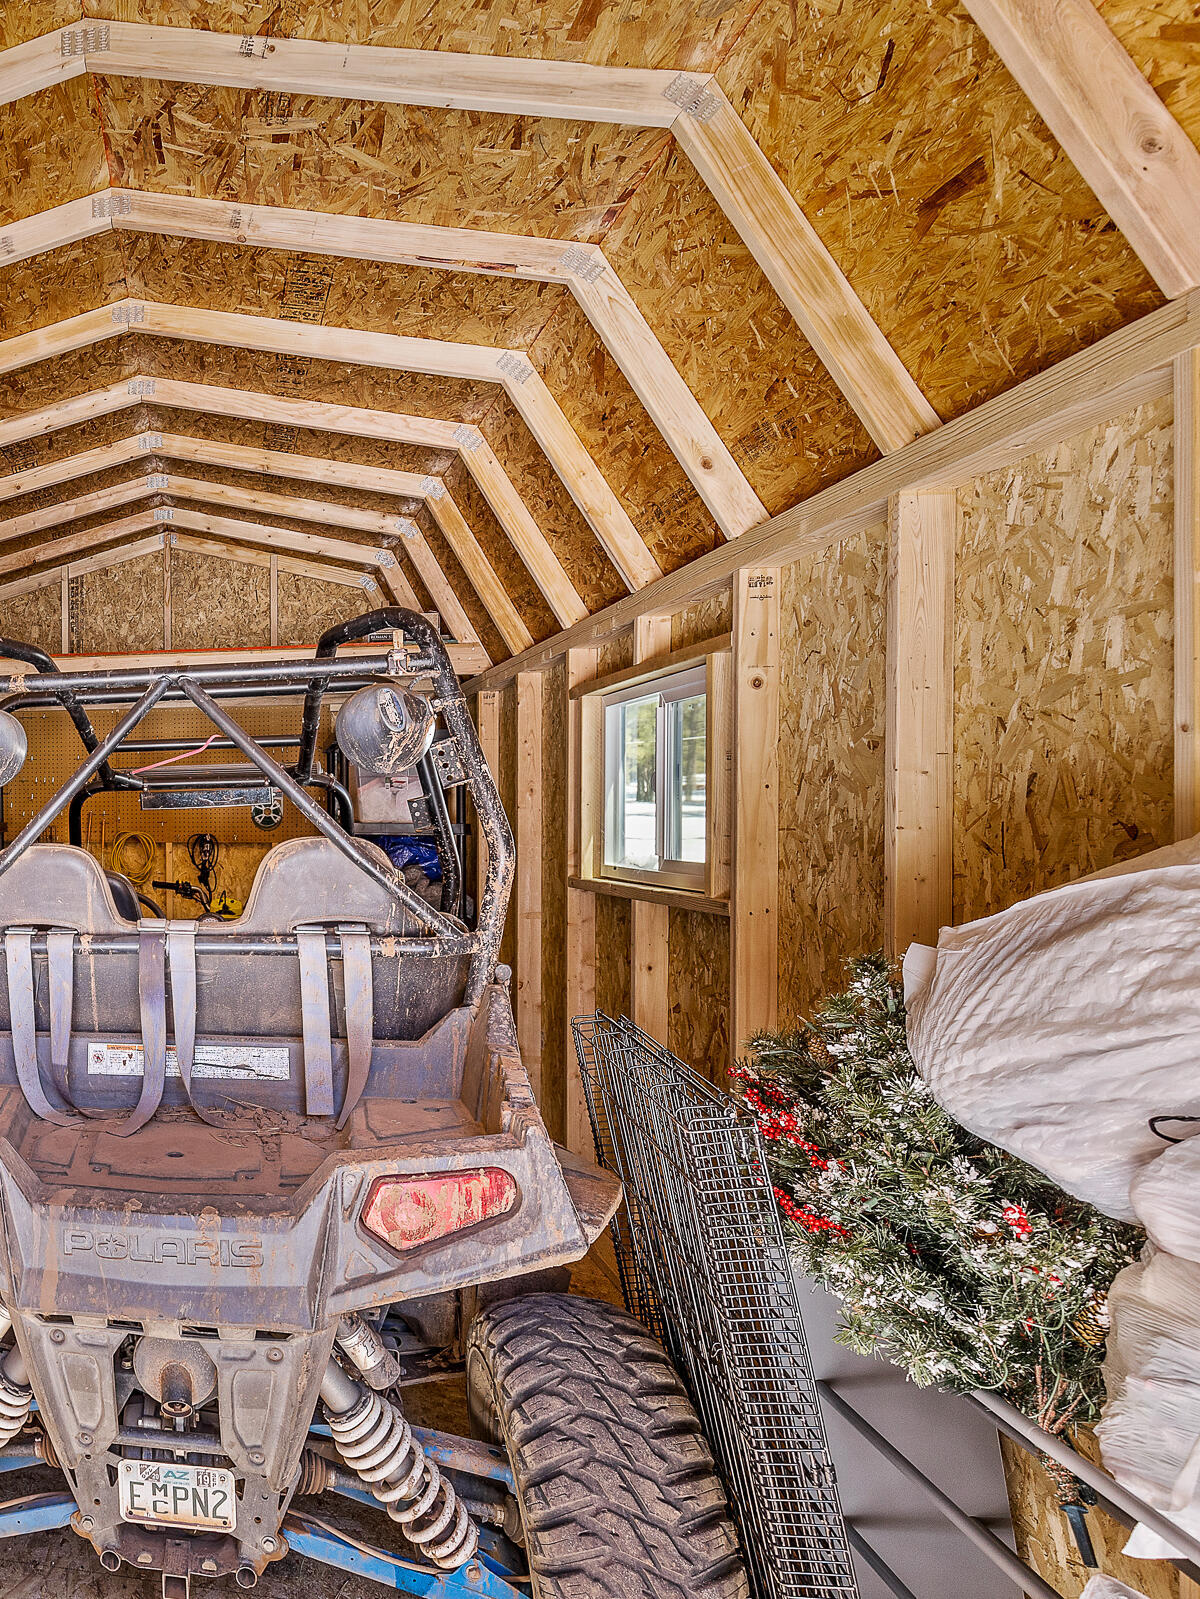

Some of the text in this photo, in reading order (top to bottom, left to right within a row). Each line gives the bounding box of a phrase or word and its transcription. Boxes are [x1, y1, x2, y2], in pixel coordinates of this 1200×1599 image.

[63, 1229, 265, 1268] POLARIS
[163, 1469, 190, 1481] AZ
[197, 1475, 210, 1486] 19
